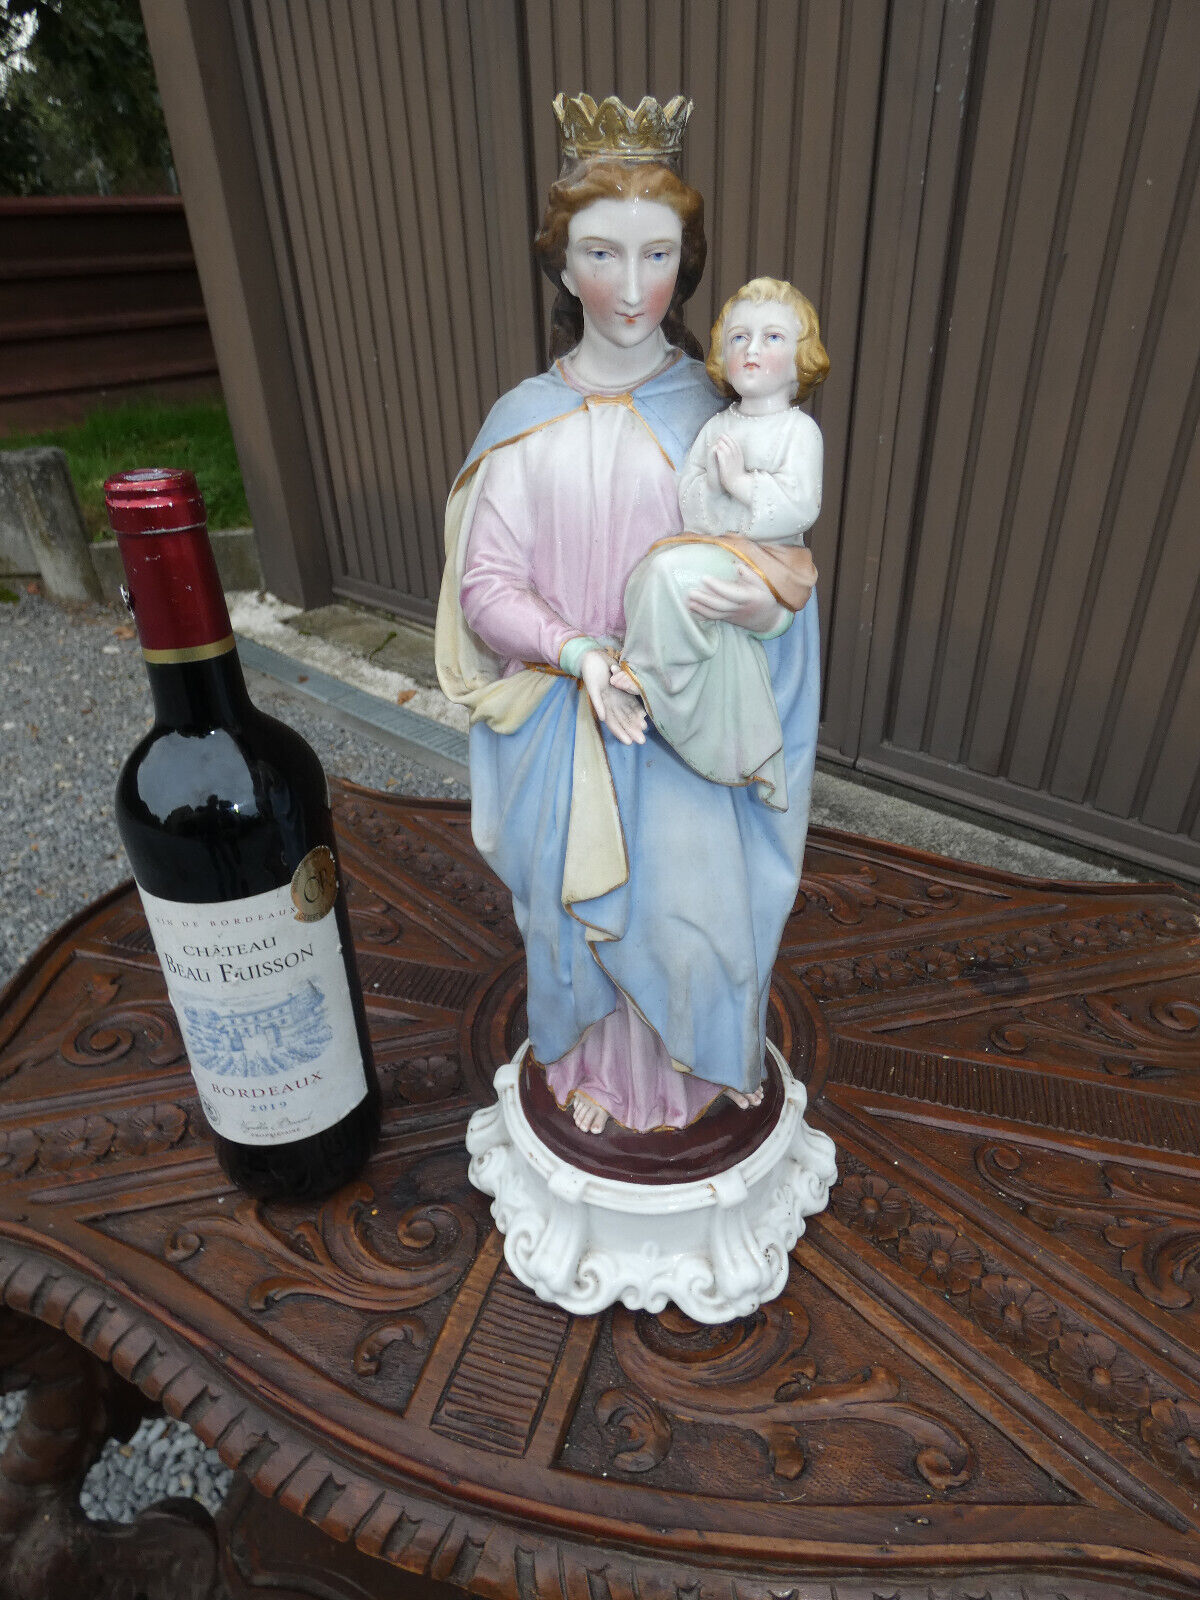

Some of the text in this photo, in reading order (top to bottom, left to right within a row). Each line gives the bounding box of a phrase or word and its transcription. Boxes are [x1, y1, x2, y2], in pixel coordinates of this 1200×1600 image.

[210, 906, 297, 928] BORDEAUX
[183, 936, 277, 958] CHÂTEAU
[164, 952, 212, 984] BEAU
[211, 1070, 324, 1099] BORDEAUX
[250, 1100, 288, 1113] 2019
